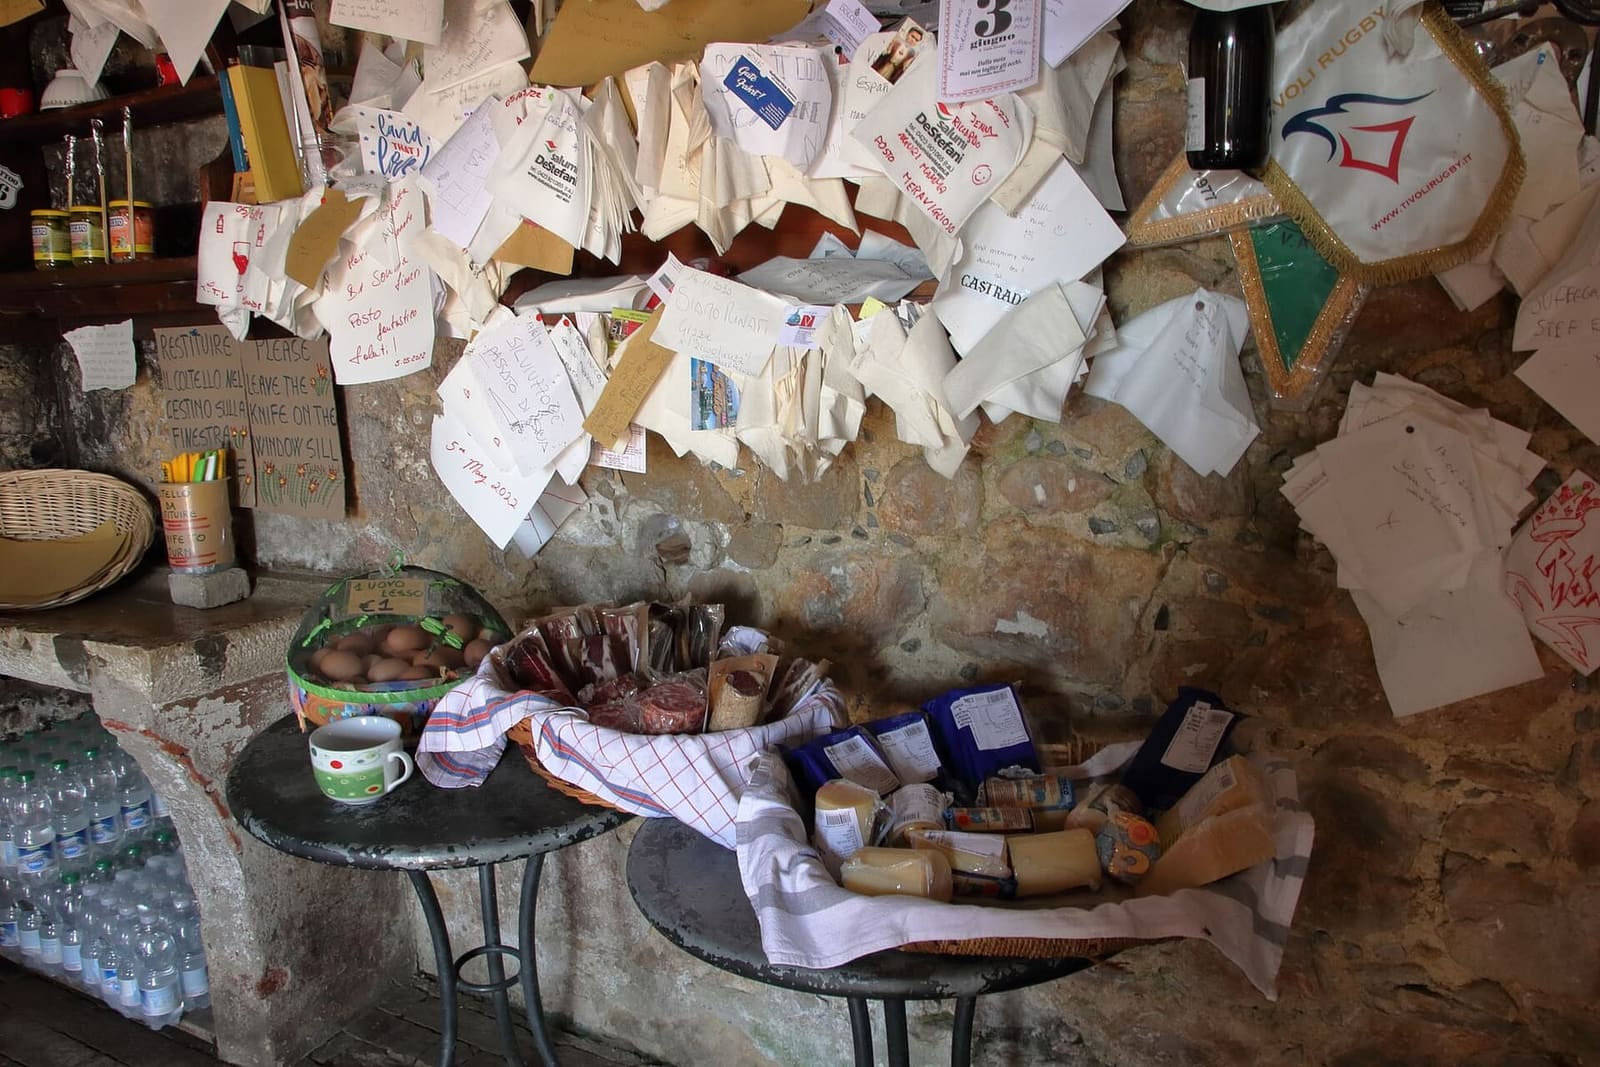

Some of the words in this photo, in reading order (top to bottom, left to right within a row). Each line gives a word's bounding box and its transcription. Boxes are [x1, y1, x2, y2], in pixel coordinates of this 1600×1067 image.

[974, 0, 1012, 37] 3
[970, 34, 1015, 50] giugno
[1318, 6, 1384, 70] RUGBY
[915, 112, 965, 165] DeStefani
[937, 120, 968, 150] salumi
[874, 135, 895, 163] POSTO
[1371, 153, 1473, 231] WWW.TIVOLIRUGBY.IT
[160, 334, 232, 360] RESTITUIRE
[255, 340, 311, 362] PLEASE
[162, 370, 173, 391] IL
[174, 369, 222, 392] COLTELLO
[226, 369, 244, 390] NEL
[246, 373, 281, 396] LEAVE
[284, 376, 308, 396] THE
[166, 399, 212, 421] CESTINO
[215, 400, 246, 419] SULLA
[250, 403, 289, 425] KNIFE
[293, 404, 312, 425] ON
[313, 405, 338, 427] THE
[172, 425, 231, 449] FINESTRA
[254, 435, 302, 458] WINDOW
[306, 438, 340, 462] SILL
[463, 457, 488, 485] May
[491, 481, 519, 510] 2022
[368, 580, 405, 591] UOVO
[381, 589, 423, 598] LESSO
[359, 599, 394, 613] €1
